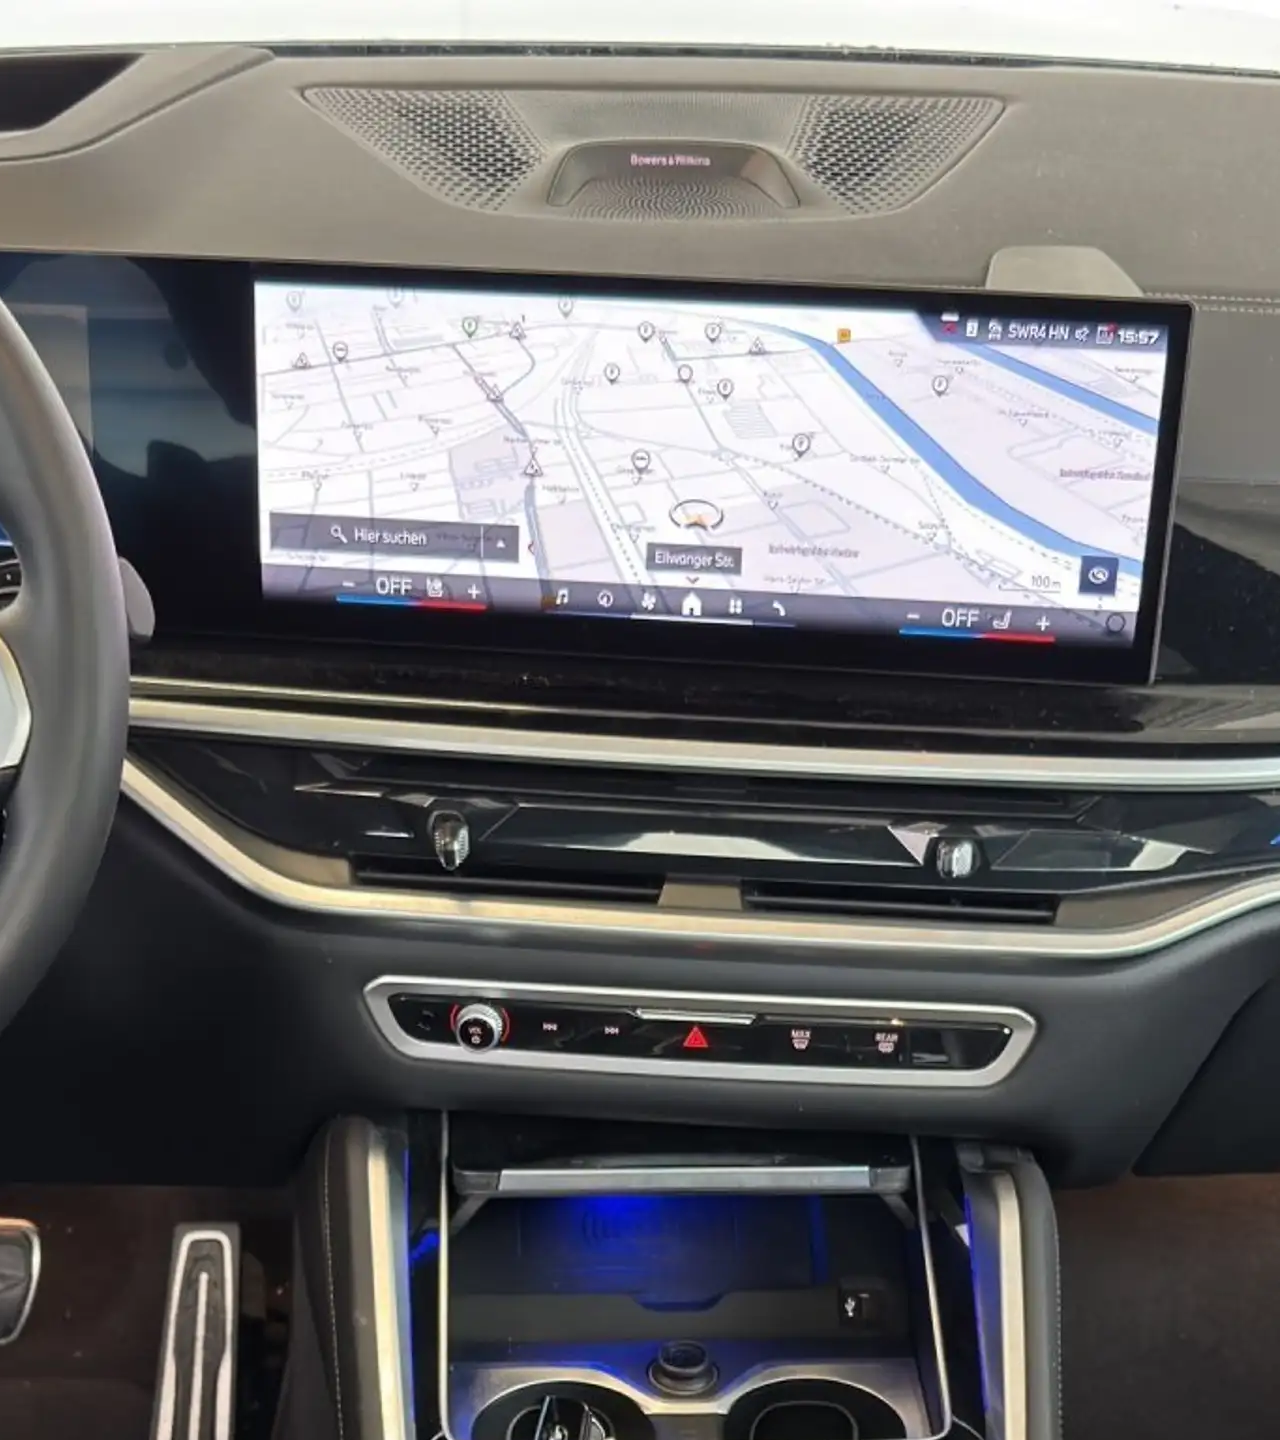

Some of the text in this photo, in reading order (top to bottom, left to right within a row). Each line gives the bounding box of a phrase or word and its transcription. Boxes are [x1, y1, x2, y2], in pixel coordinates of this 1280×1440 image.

[1008, 321, 1069, 341] SWR4 HN
[1117, 328, 1161, 344] 15:57
[354, 527, 381, 543] Hier
[382, 530, 427, 546] suchen
[375, 576, 412, 596] OFF
[1031, 575, 1051, 588] 100
[941, 607, 980, 628] OFF
